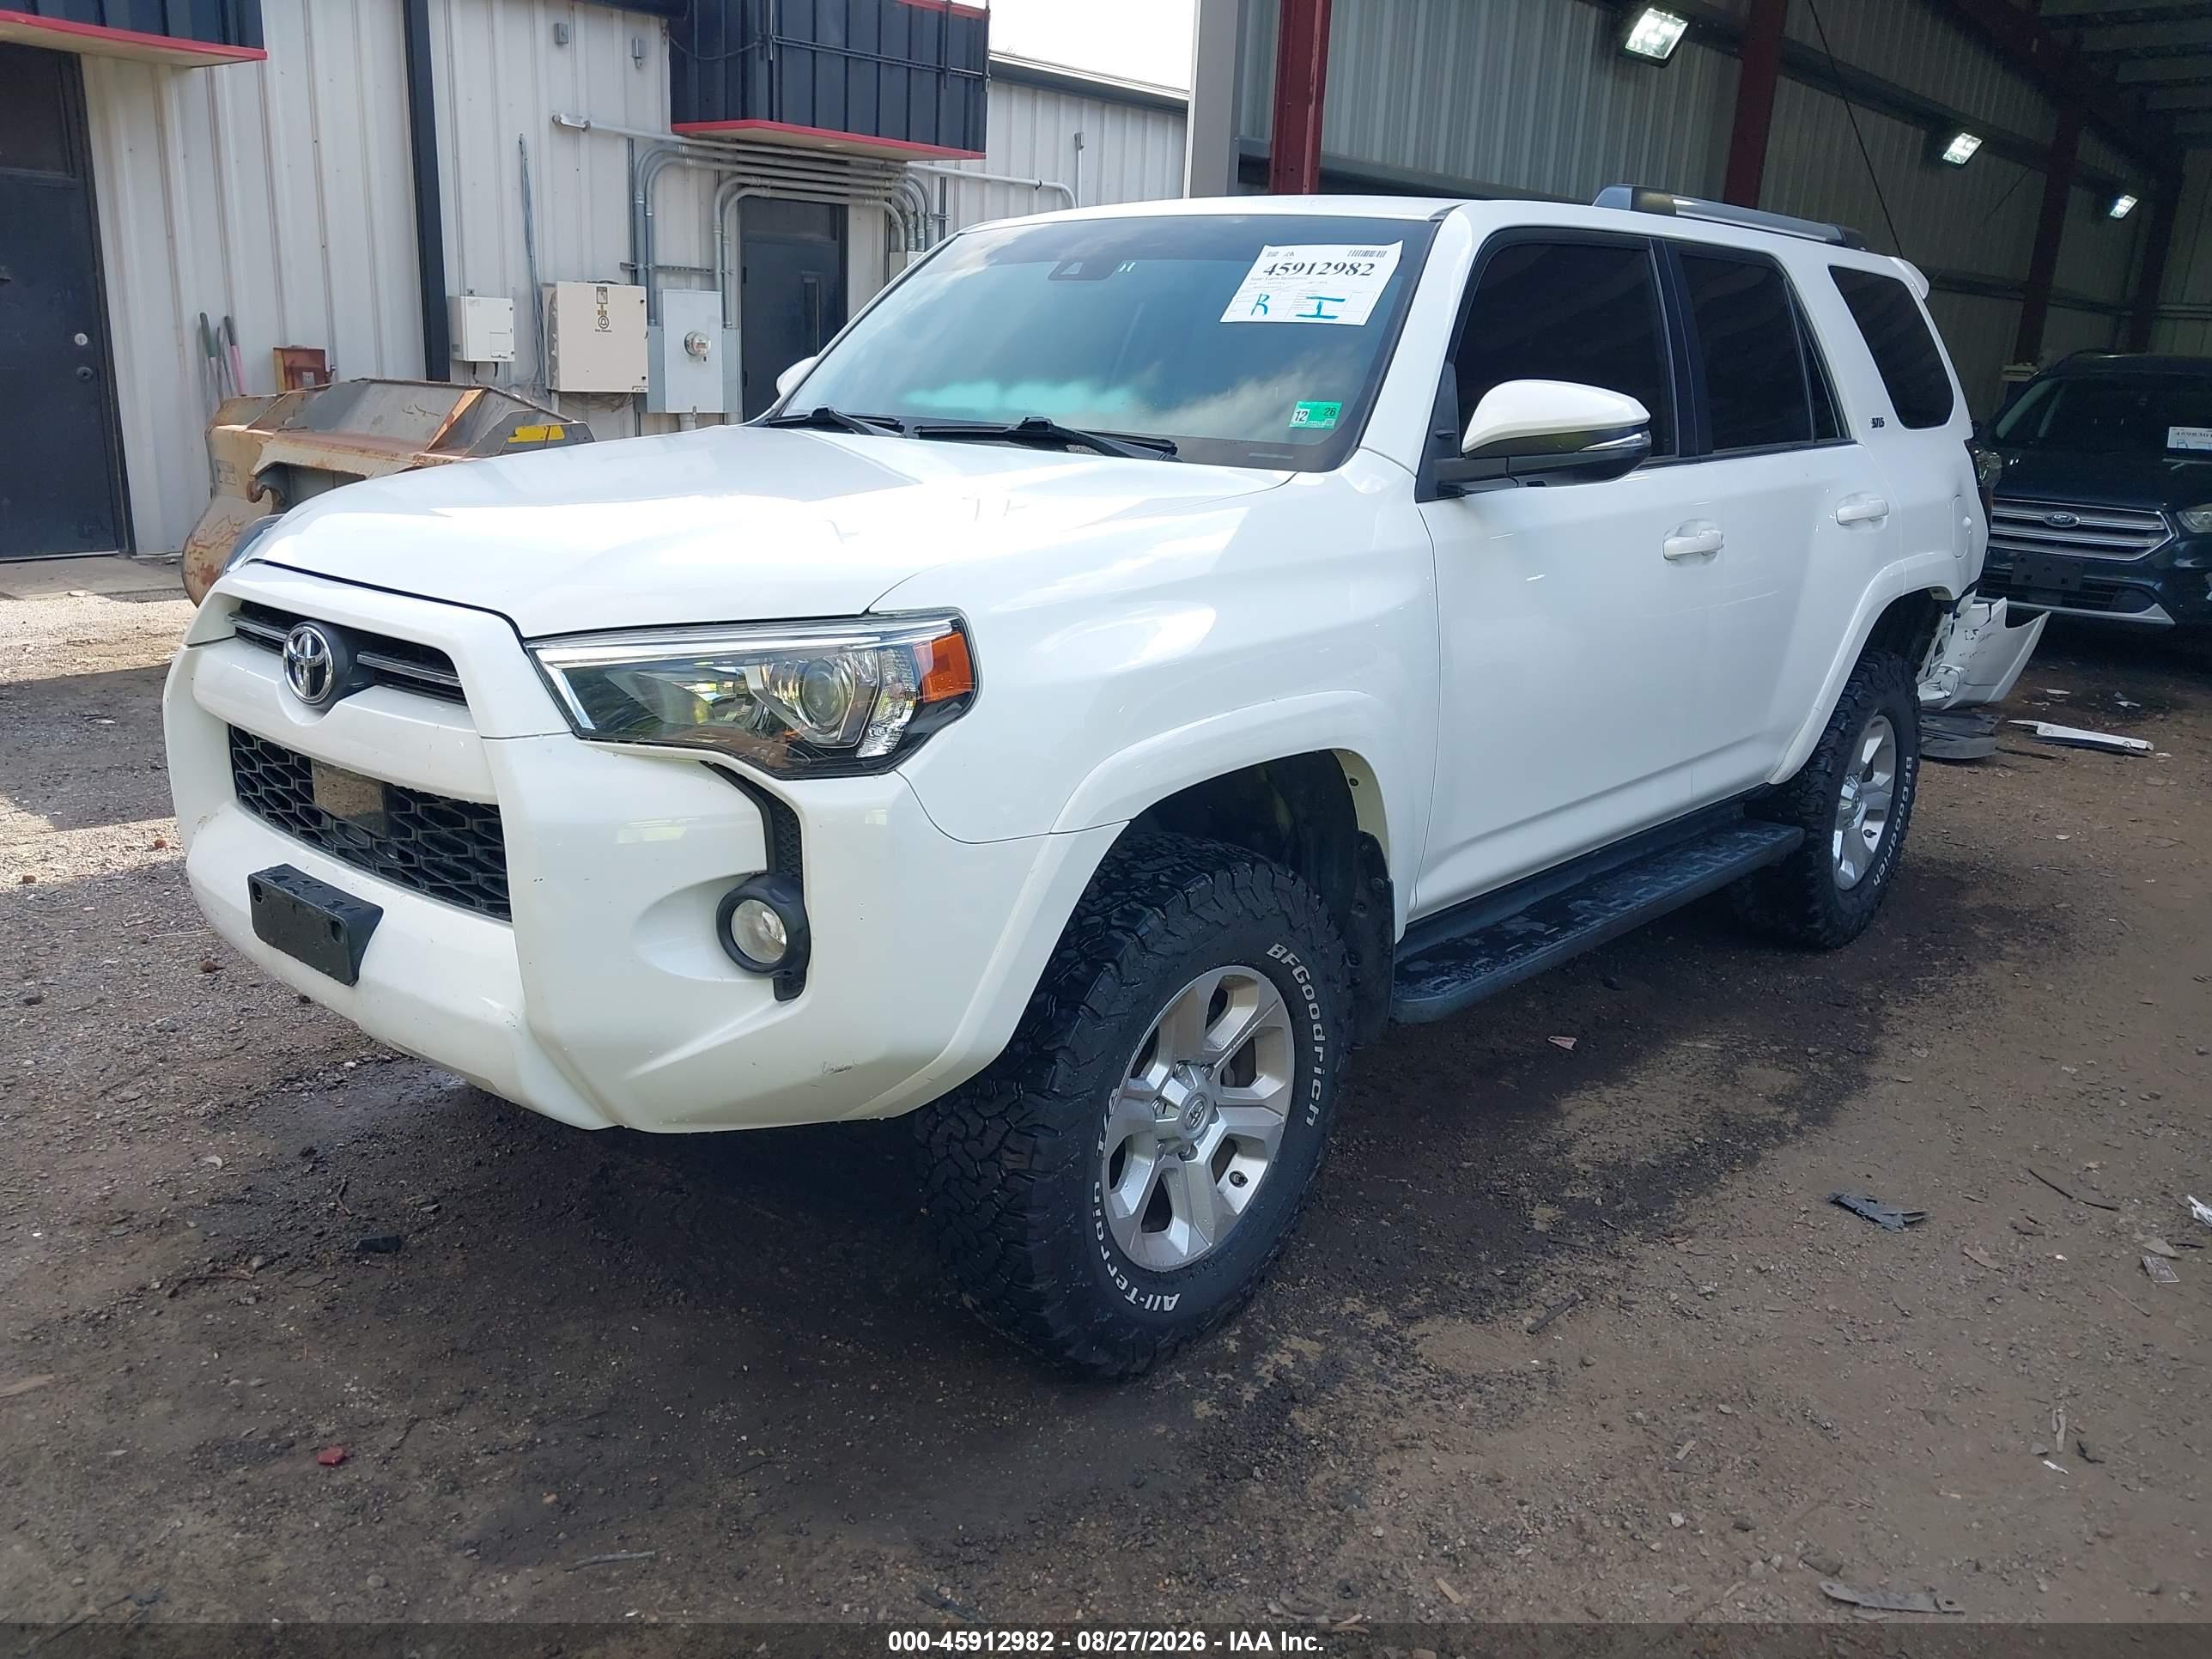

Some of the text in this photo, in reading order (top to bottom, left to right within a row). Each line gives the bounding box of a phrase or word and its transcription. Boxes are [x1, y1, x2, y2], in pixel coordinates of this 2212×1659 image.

[1263, 261, 1376, 276] 45912982
[1250, 293, 1271, 316] R
[1295, 410, 1309, 422] 12
[1323, 407, 1337, 417] 26
[1873, 757, 1913, 887] BFGoodrich
[1266, 943, 1327, 1127] BFGoodrich
[1092, 1181, 1181, 1313] All-Terrain
